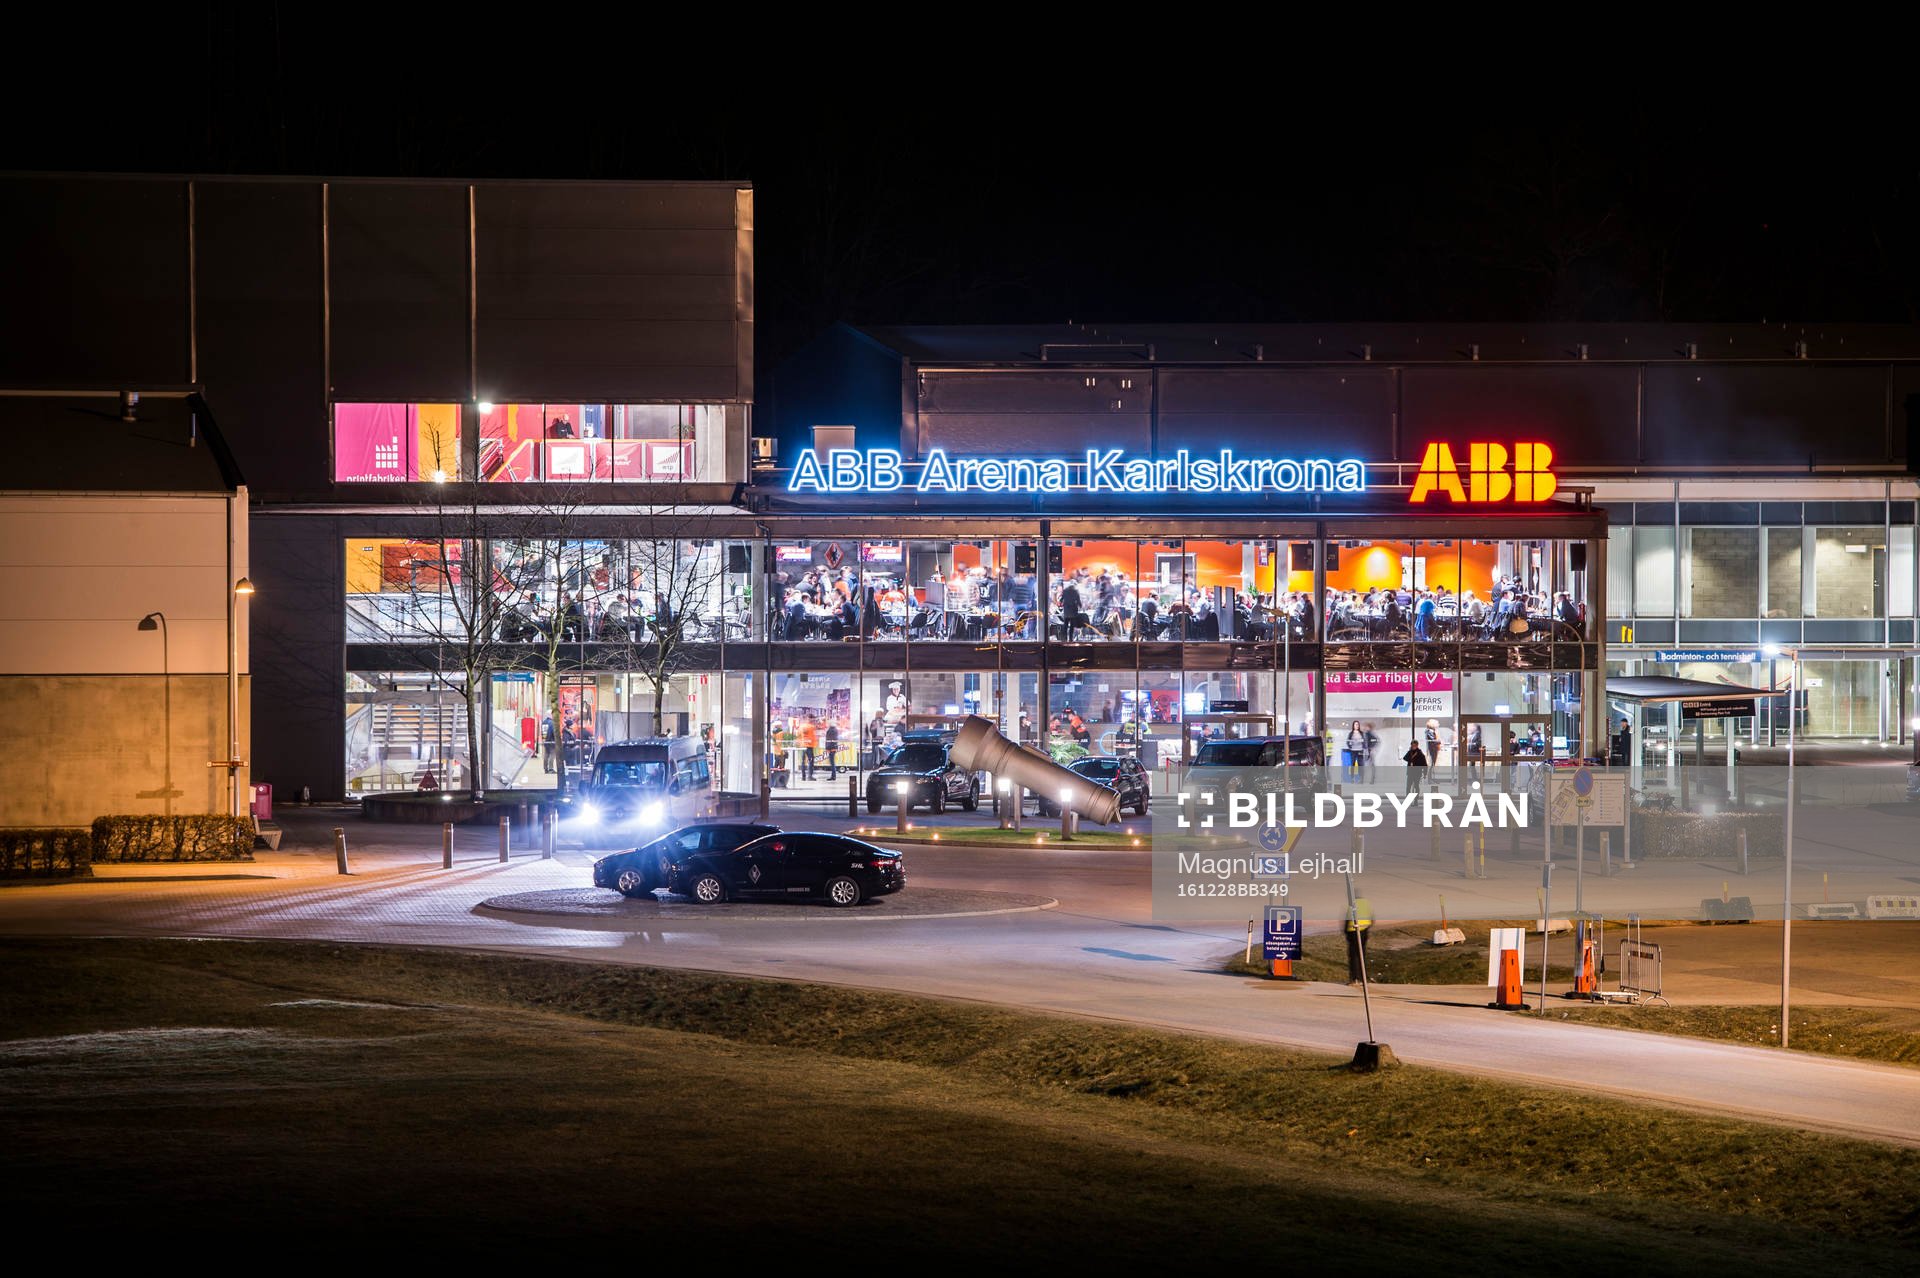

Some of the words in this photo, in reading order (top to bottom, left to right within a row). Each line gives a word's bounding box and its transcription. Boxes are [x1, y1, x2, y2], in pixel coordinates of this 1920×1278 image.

[788, 449, 903, 492] ABB
[917, 449, 1069, 492] Arena
[1087, 449, 1366, 492] Karlskrona
[1409, 443, 1557, 502] ABB
[1661, 652, 1704, 660] Badminton-
[1706, 652, 1719, 660] och
[1721, 652, 1755, 660] tennishall
[1344, 672, 1382, 684] äskar
[1276, 911, 1291, 931] P
